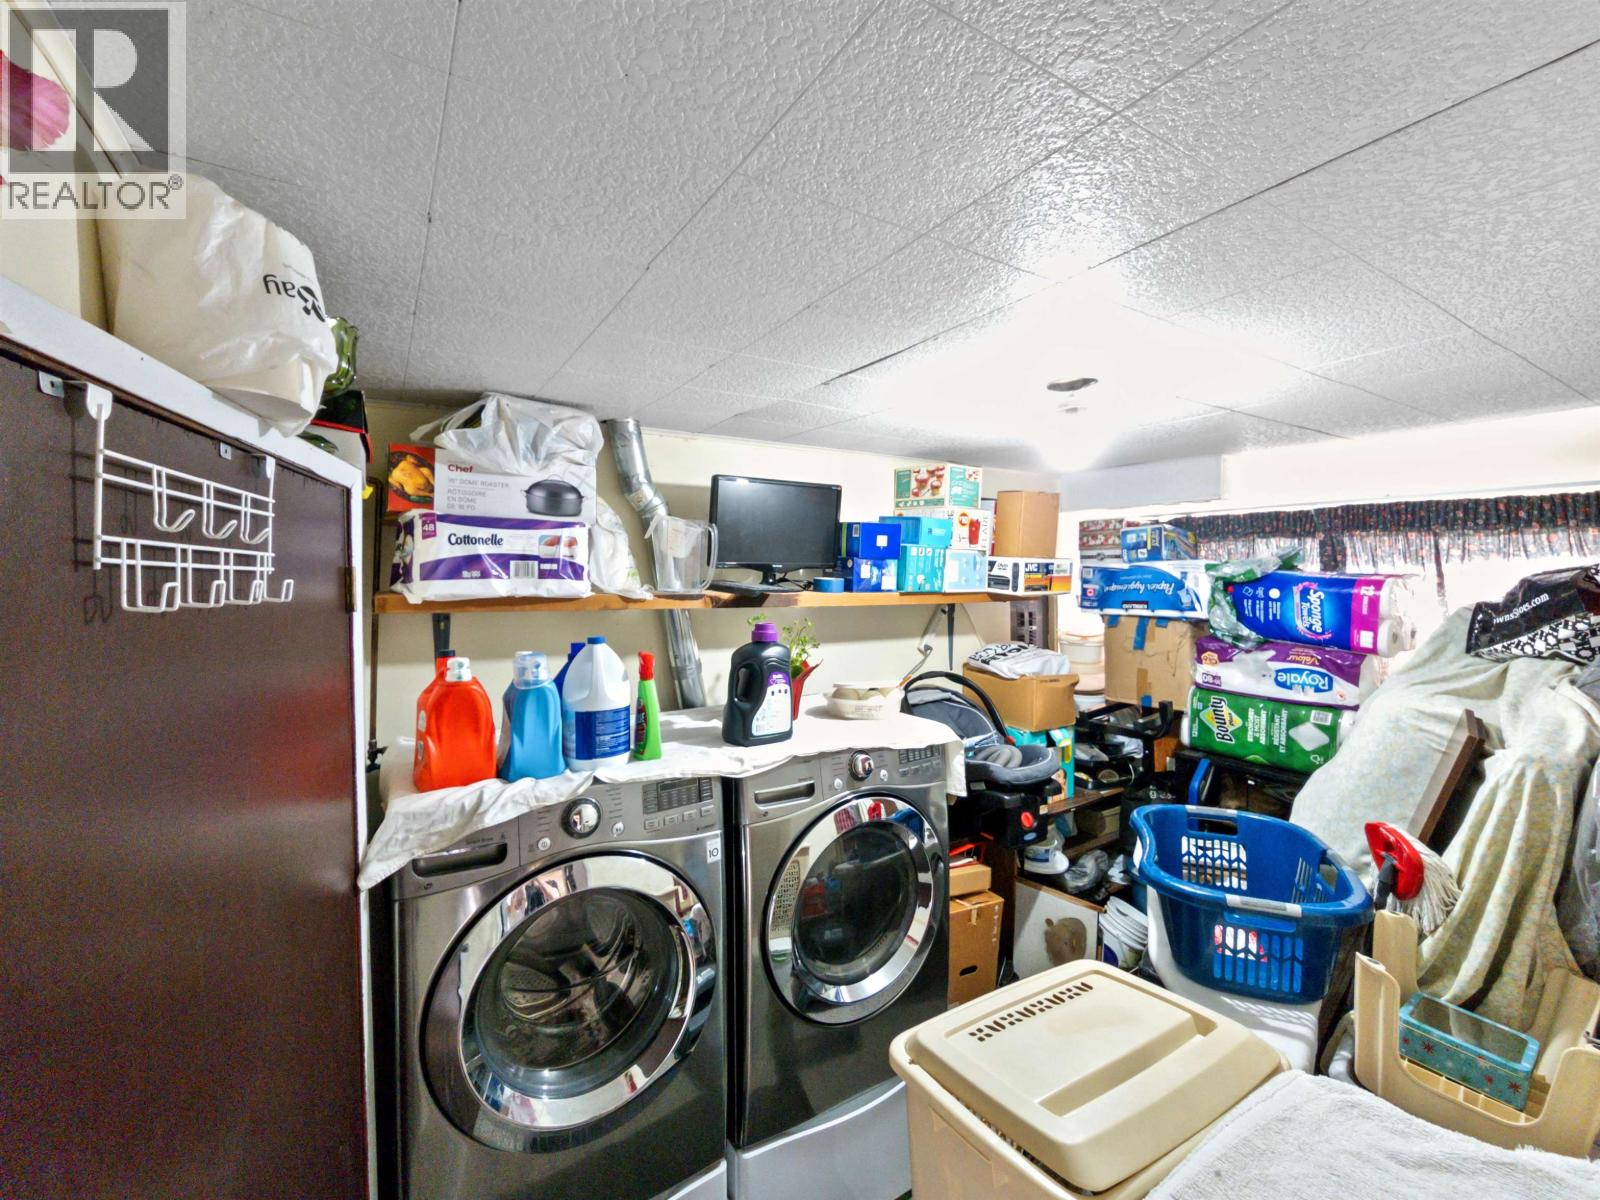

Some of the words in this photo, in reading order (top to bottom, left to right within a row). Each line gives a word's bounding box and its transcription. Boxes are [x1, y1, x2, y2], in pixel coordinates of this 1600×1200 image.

[447, 463, 474, 473] Chef
[447, 532, 504, 547] Cottonelle
[1025, 563, 1038, 572] JVC
[1146, 580, 1175, 596] Papier
[1360, 585, 1375, 596] 12
[1300, 601, 1311, 629] Towels
[1306, 589, 1326, 633] Sponge
[1276, 670, 1329, 690] Royale
[1210, 696, 1235, 743] Bounty
